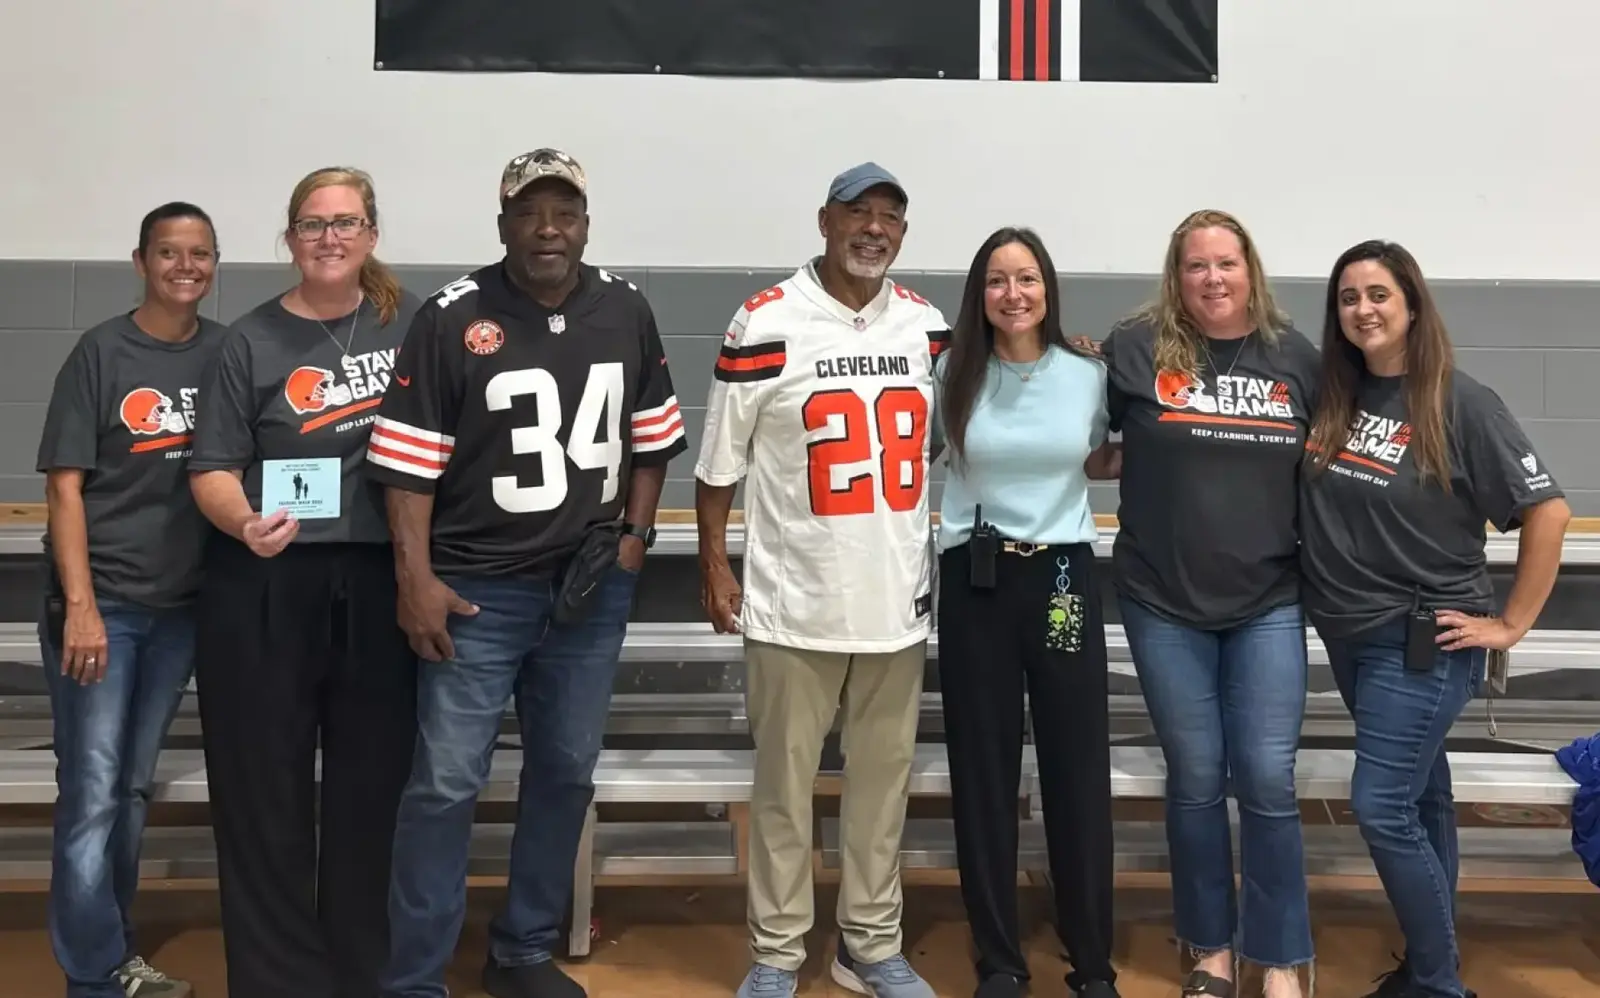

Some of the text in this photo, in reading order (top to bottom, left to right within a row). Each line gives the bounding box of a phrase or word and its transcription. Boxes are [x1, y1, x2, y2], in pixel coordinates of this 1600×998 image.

[430, 274, 480, 309] 4
[341, 348, 396, 379] STAY
[815, 356, 910, 378] CLEVELAND
[1216, 375, 1274, 400] STAY
[1217, 395, 1293, 418] GAME!
[335, 421, 354, 433] KEEP
[485, 362, 624, 513] 34
[1191, 428, 1297, 444] KEEP LEARNING, EVERY DAY
[801, 386, 928, 516] 28
[1353, 470, 1374, 482] EVERY
[1373, 477, 1389, 487] DAY
